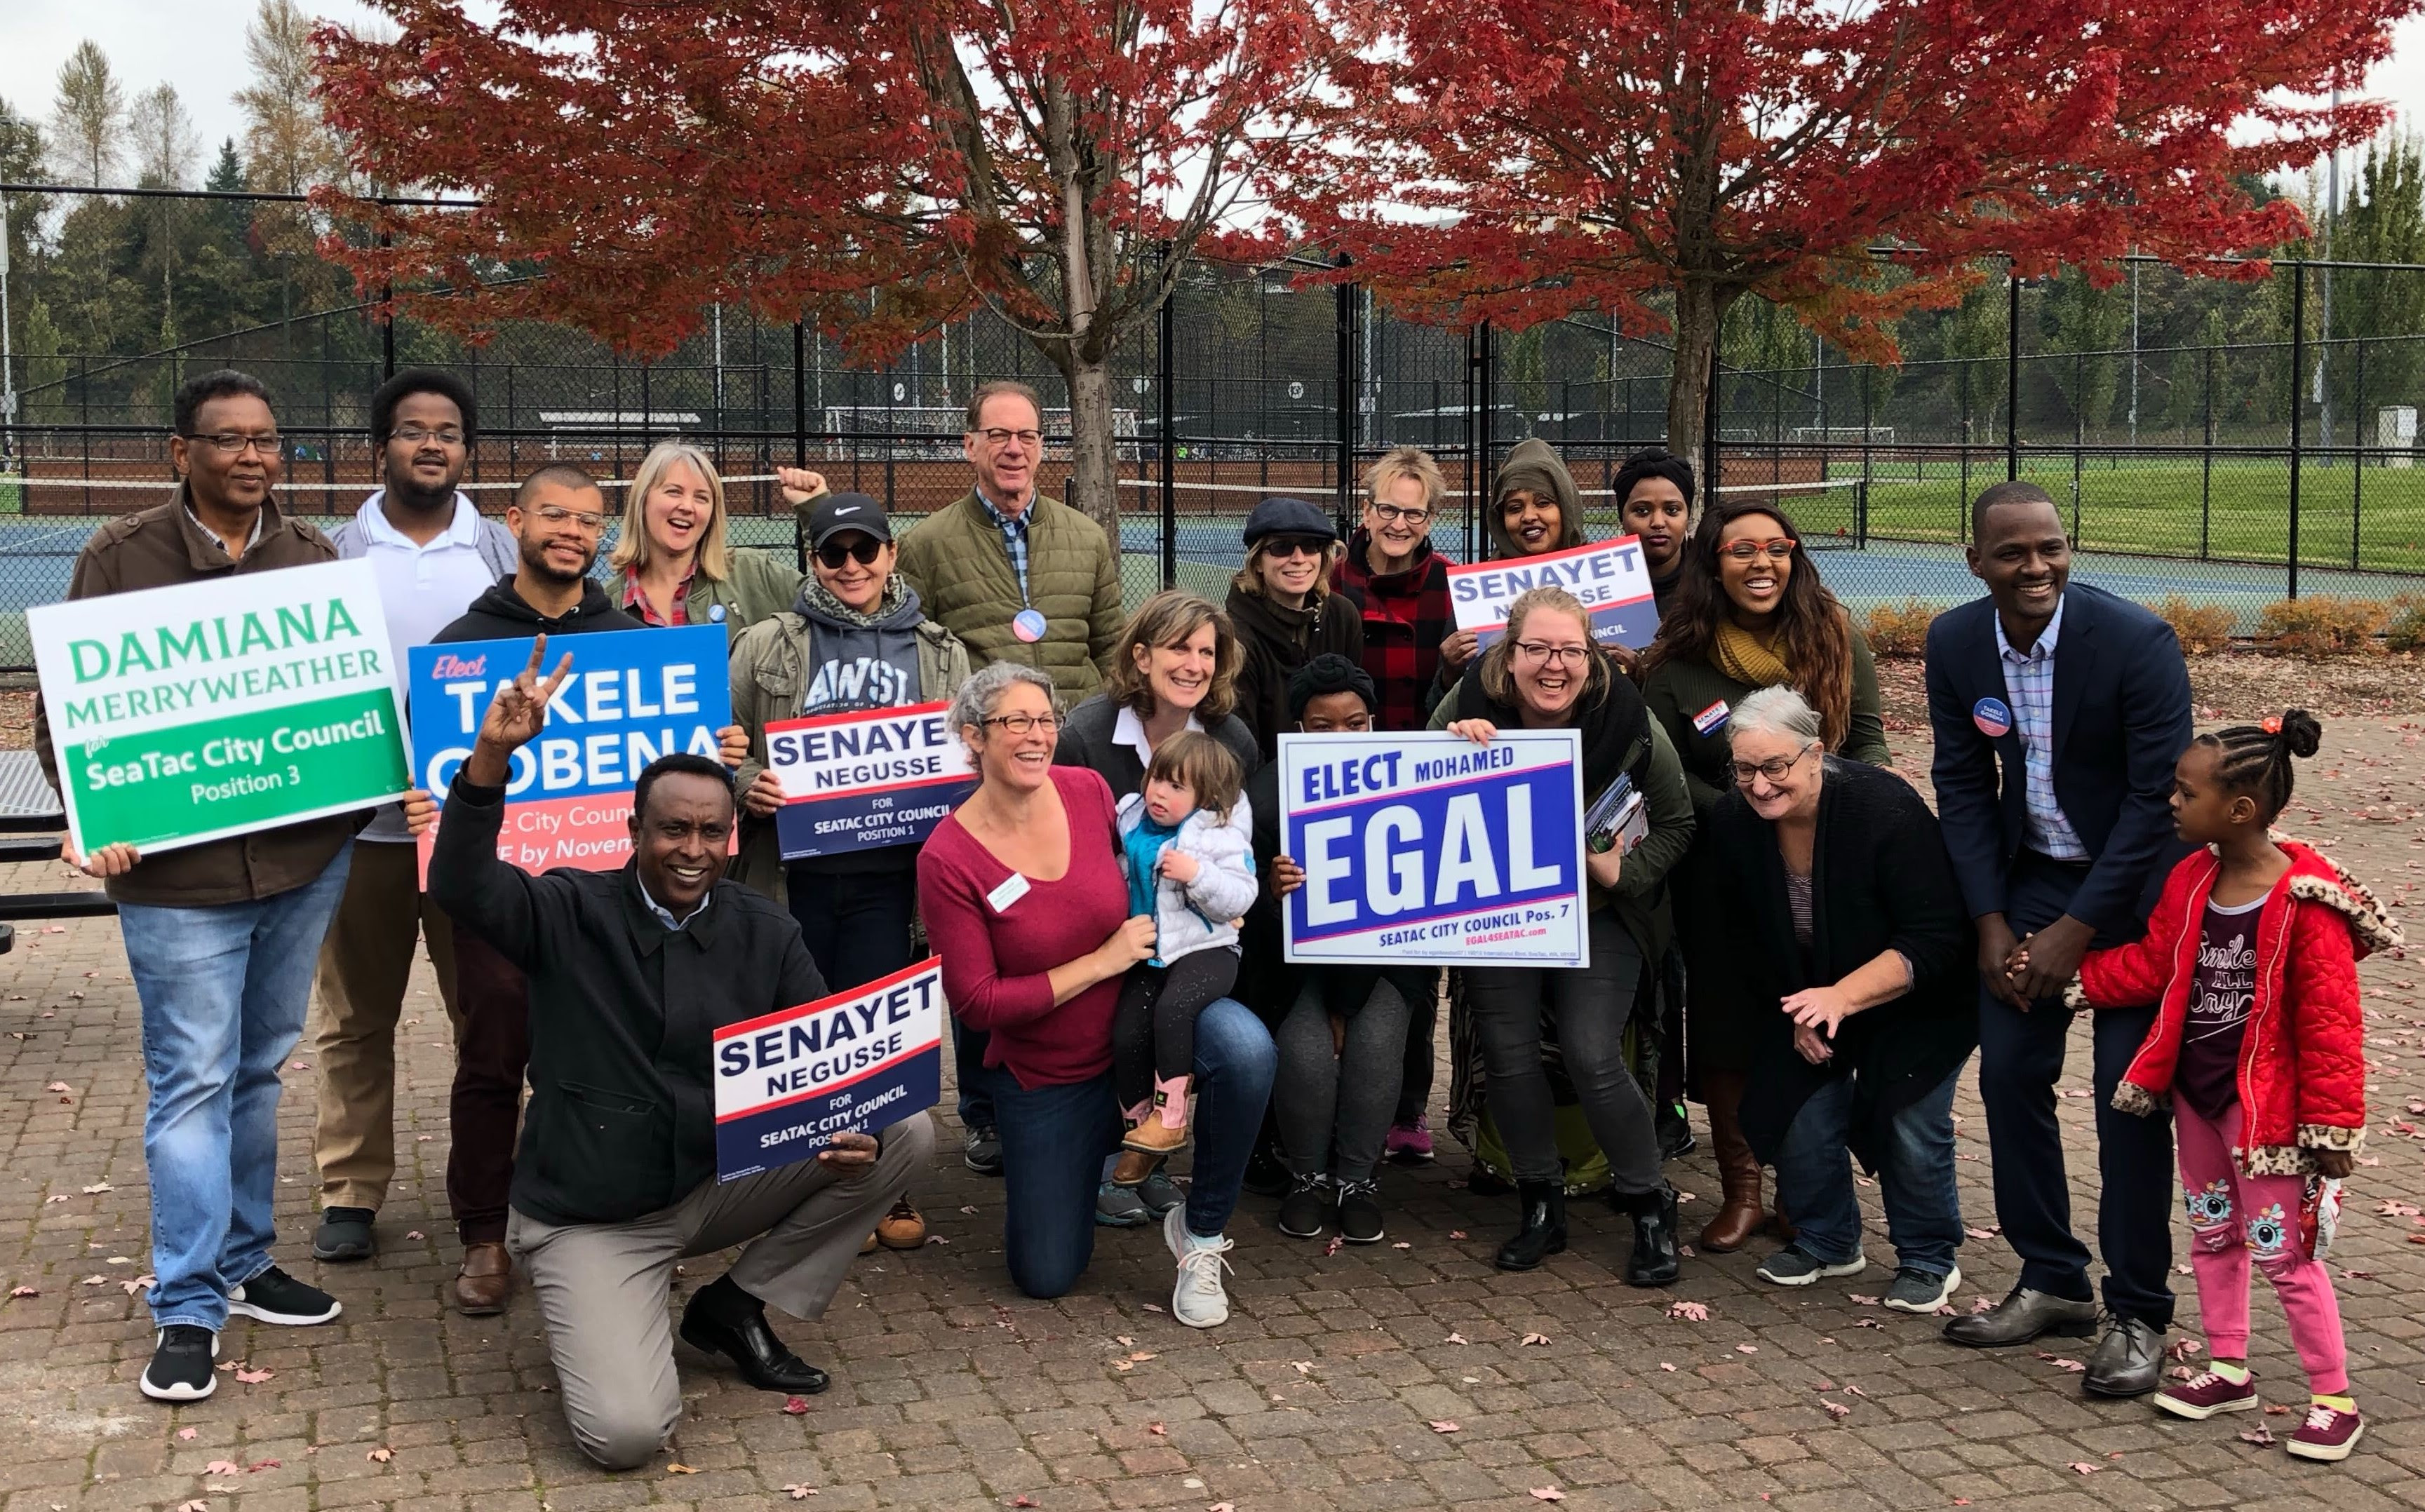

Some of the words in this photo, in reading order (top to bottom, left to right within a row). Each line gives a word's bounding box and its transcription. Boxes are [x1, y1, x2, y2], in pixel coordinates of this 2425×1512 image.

[1453, 546, 1638, 602] SENAYET
[67, 598, 362, 684] DAMIANA
[1590, 624, 1627, 640] UNCIL
[432, 655, 487, 680] Elect
[64, 648, 383, 729] MERRYWEATHER
[445, 663, 701, 734] TKELE
[84, 736, 109, 760] for
[86, 748, 196, 790] SeaTac
[202, 736, 264, 769] City
[271, 709, 385, 753] Council
[772, 717, 946, 766] SENAYE
[191, 771, 282, 804] Position
[287, 764, 300, 785] 3
[815, 755, 942, 789] NEGUSSE
[1303, 750, 1402, 804] ELECT
[1414, 745, 1514, 783] MOHAMED
[517, 811, 562, 835] City
[569, 806, 635, 826] Coun
[872, 797, 893, 809] FOR
[814, 816, 862, 835] SEATAC
[864, 811, 894, 826] CITY
[857, 827, 906, 842] POSITION
[908, 825, 915, 835] 1
[520, 843, 549, 868] by
[1304, 782, 1561, 928] EGAL
[1379, 927, 1426, 947] SEATAC
[1431, 922, 1458, 938] CITY
[1464, 912, 1521, 932] COUNCIL
[1526, 910, 1554, 923] Pos.
[1560, 904, 1569, 917] 7
[1465, 928, 1547, 946] EGAL4SEATAC.com
[2197, 930, 2257, 969] Smile
[2212, 971, 2254, 988] ALL
[720, 973, 939, 1077] SENAYET
[767, 1032, 903, 1097] NEGUSSE
[760, 1121, 816, 1148] SEATAC
[819, 1109, 852, 1131] CITY
[854, 1084, 908, 1119] COUNCIL
[829, 1093, 852, 1111] FOR
[863, 1118, 868, 1129] 1
